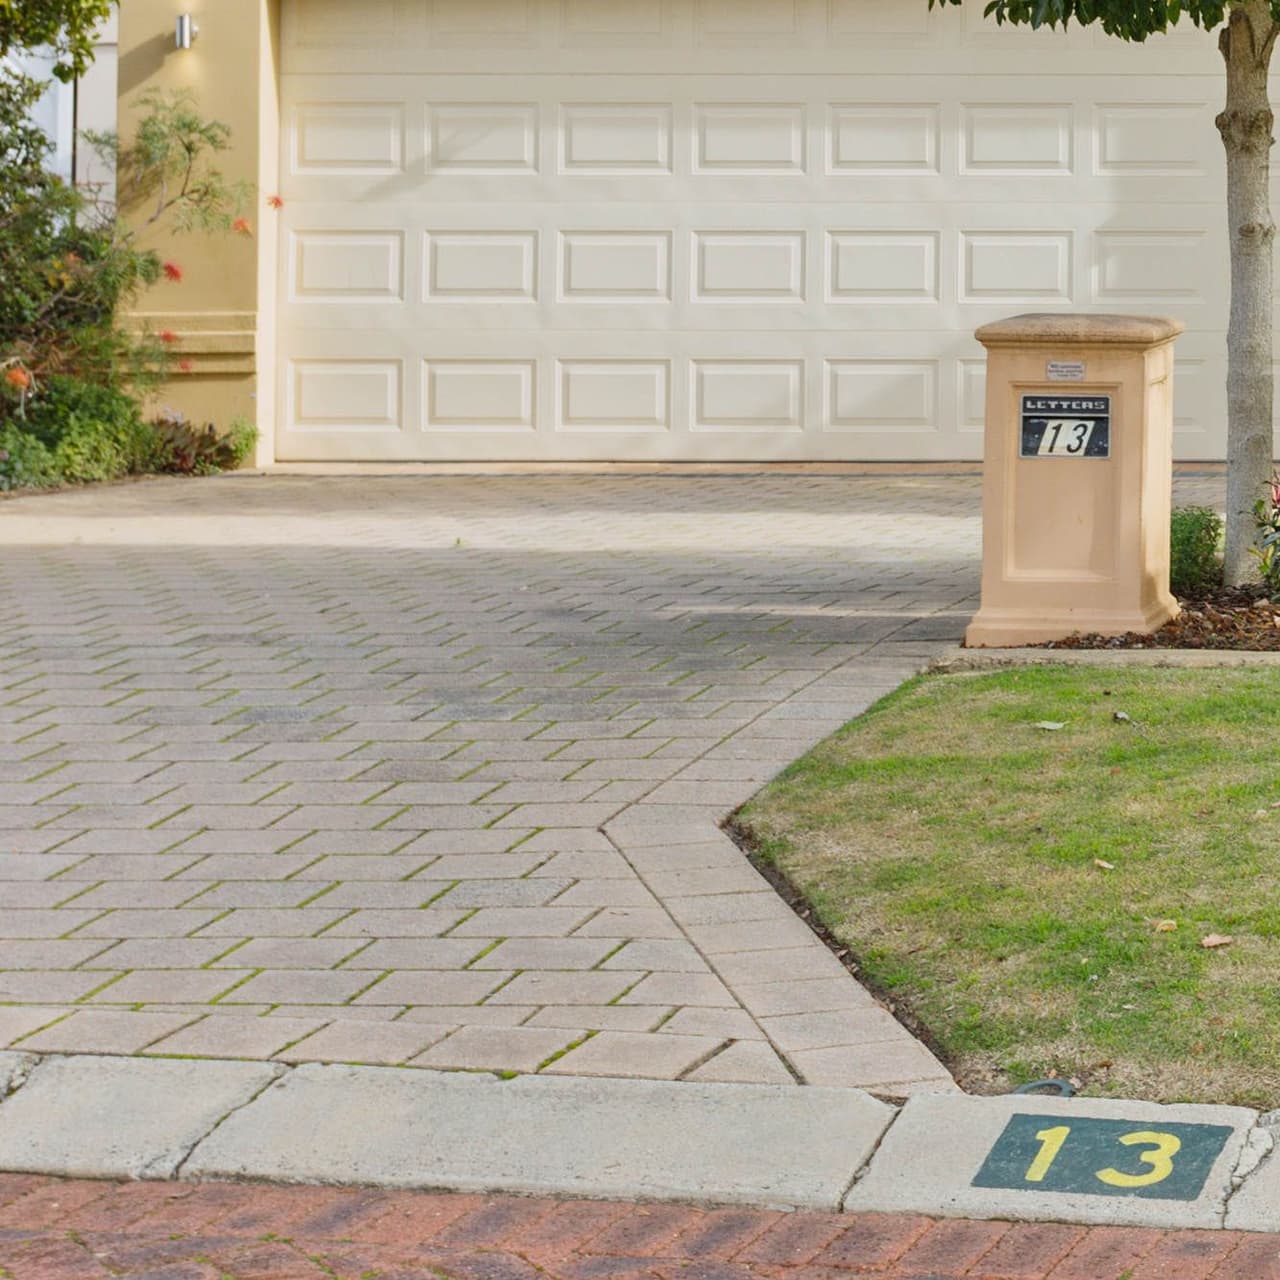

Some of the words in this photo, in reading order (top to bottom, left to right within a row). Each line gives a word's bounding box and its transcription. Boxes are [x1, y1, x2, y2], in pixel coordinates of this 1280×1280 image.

[1026, 400, 1105, 410] LETTERS
[1047, 423, 1089, 454] 13
[1024, 1125, 1182, 1188] 13
